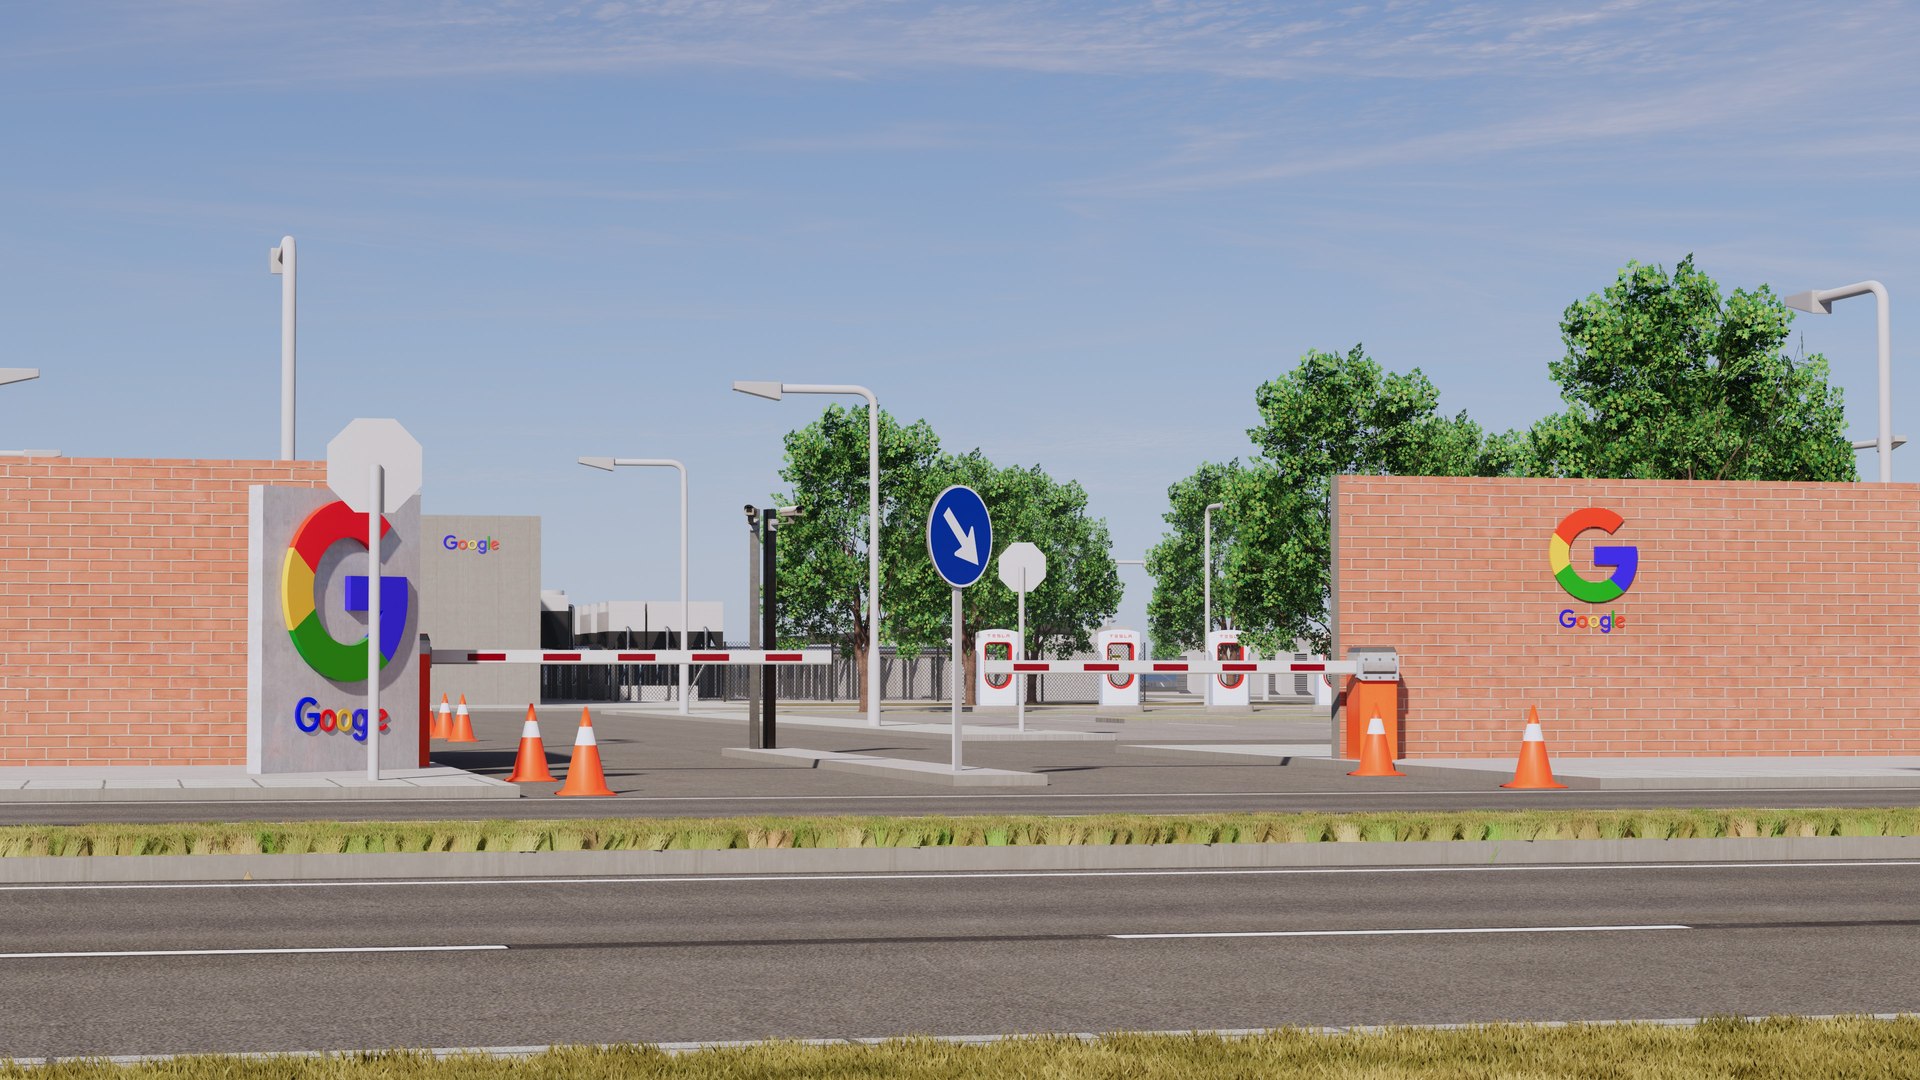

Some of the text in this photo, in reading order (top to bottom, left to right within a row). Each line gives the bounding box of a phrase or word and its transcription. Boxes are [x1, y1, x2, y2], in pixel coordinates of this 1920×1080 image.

[443, 534, 500, 554] Google
[1559, 609, 1626, 633] Google
[295, 697, 388, 741] Googe
